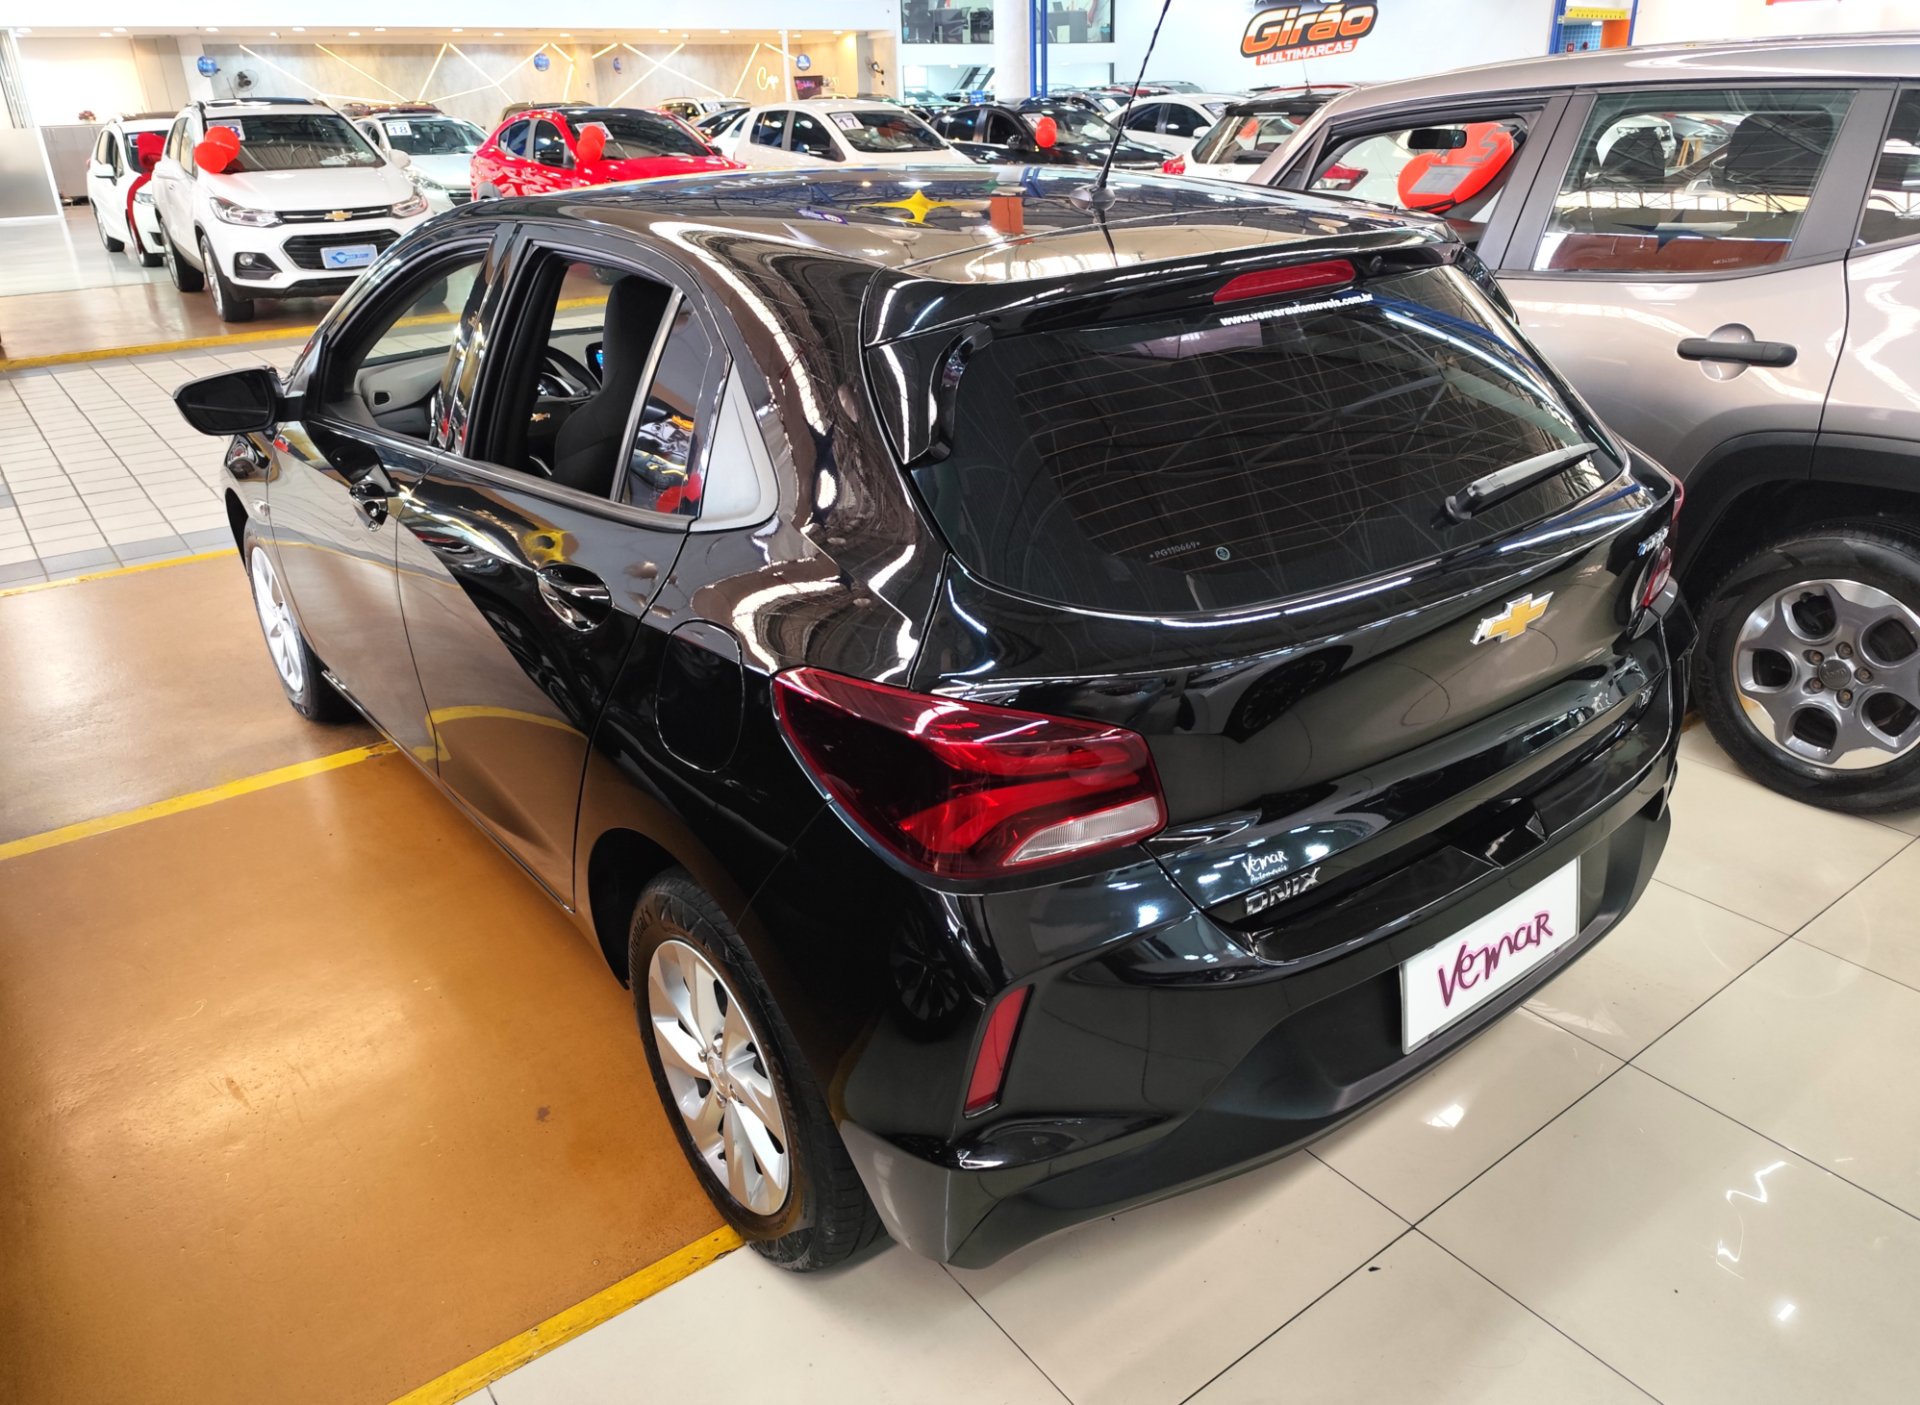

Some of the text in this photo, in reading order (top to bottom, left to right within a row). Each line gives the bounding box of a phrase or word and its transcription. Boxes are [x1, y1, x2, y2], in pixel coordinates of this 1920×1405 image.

[1259, 40, 1354, 65] MULTIMARCAS
[391, 126, 408, 135] 18
[839, 117, 856, 129] 17
[1219, 292, 1374, 327] www.vemarautomoveis.com.br
